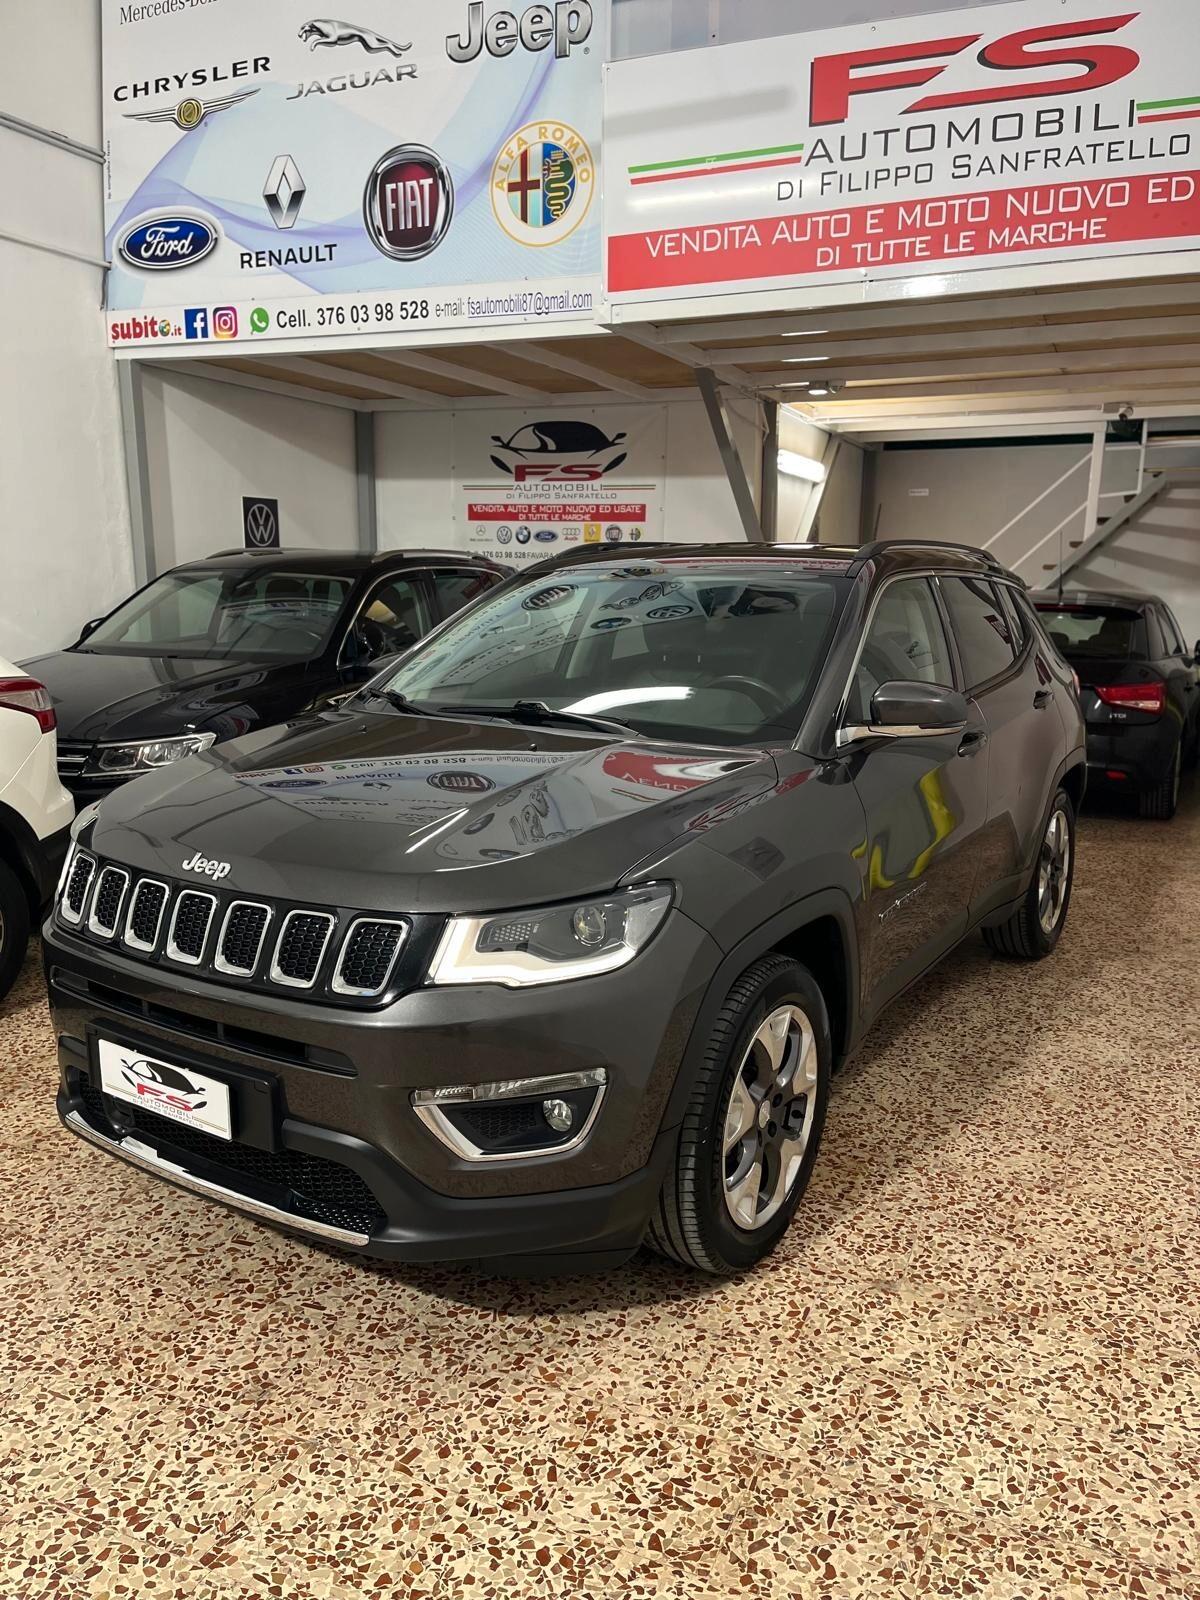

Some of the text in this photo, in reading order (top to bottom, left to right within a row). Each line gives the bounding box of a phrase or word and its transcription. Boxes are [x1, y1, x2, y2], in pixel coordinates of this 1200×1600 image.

[446, 0, 593, 63] Jeep
[113, 56, 271, 101] CHRYSLER
[286, 63, 418, 100] JAGUAR
[809, 12, 1142, 127] FS
[804, 99, 1135, 167] AUTOMOBILI
[495, 126, 591, 191] ALFA ROMEO
[777, 133, 1190, 201] DI FILIPPO SANFRATELLO
[385, 178, 434, 232] FIAT
[645, 176, 1195, 257] VENDITA AUTO E MOTO NUOVO ED
[141, 226, 194, 259] Ford
[240, 244, 338, 269] RENAULT
[816, 217, 1107, 267] DI TUTTE LE MARCHE
[276, 290, 592, 328] Cell. 376 03 98 528 e-mail: fsautomobili87@gmail.com
[514, 484, 603, 492] AUTOMOBILI
[515, 464, 602, 481] FS
[472, 505, 505, 513] VENDITA
[182, 851, 231, 880] Jeep
[137, 1083, 193, 1111] FS
[137, 1095, 194, 1120] AUTOMOBILI
